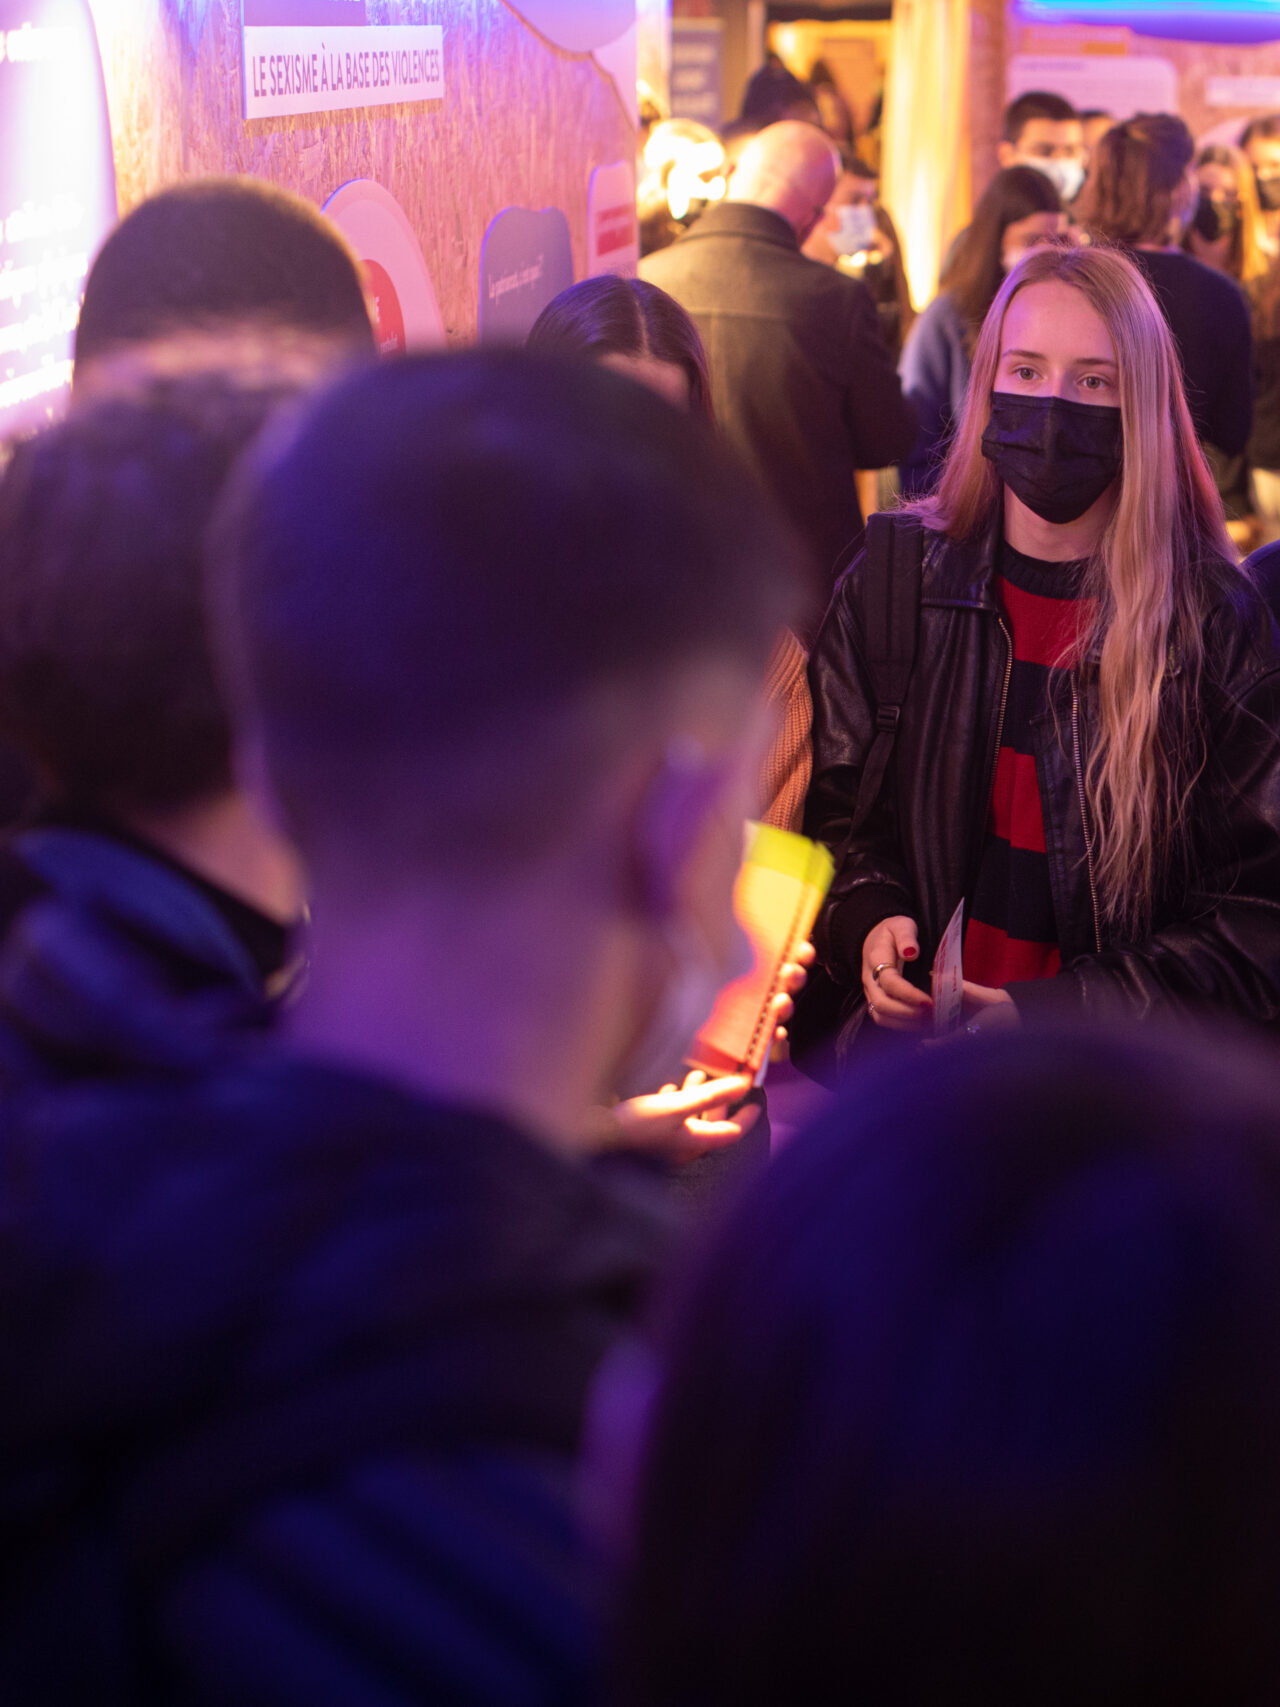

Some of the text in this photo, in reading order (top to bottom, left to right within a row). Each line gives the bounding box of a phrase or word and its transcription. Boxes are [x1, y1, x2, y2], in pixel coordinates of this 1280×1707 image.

[253, 42, 440, 97] LE SEXISME À LA BASE DES VIOLENCES
